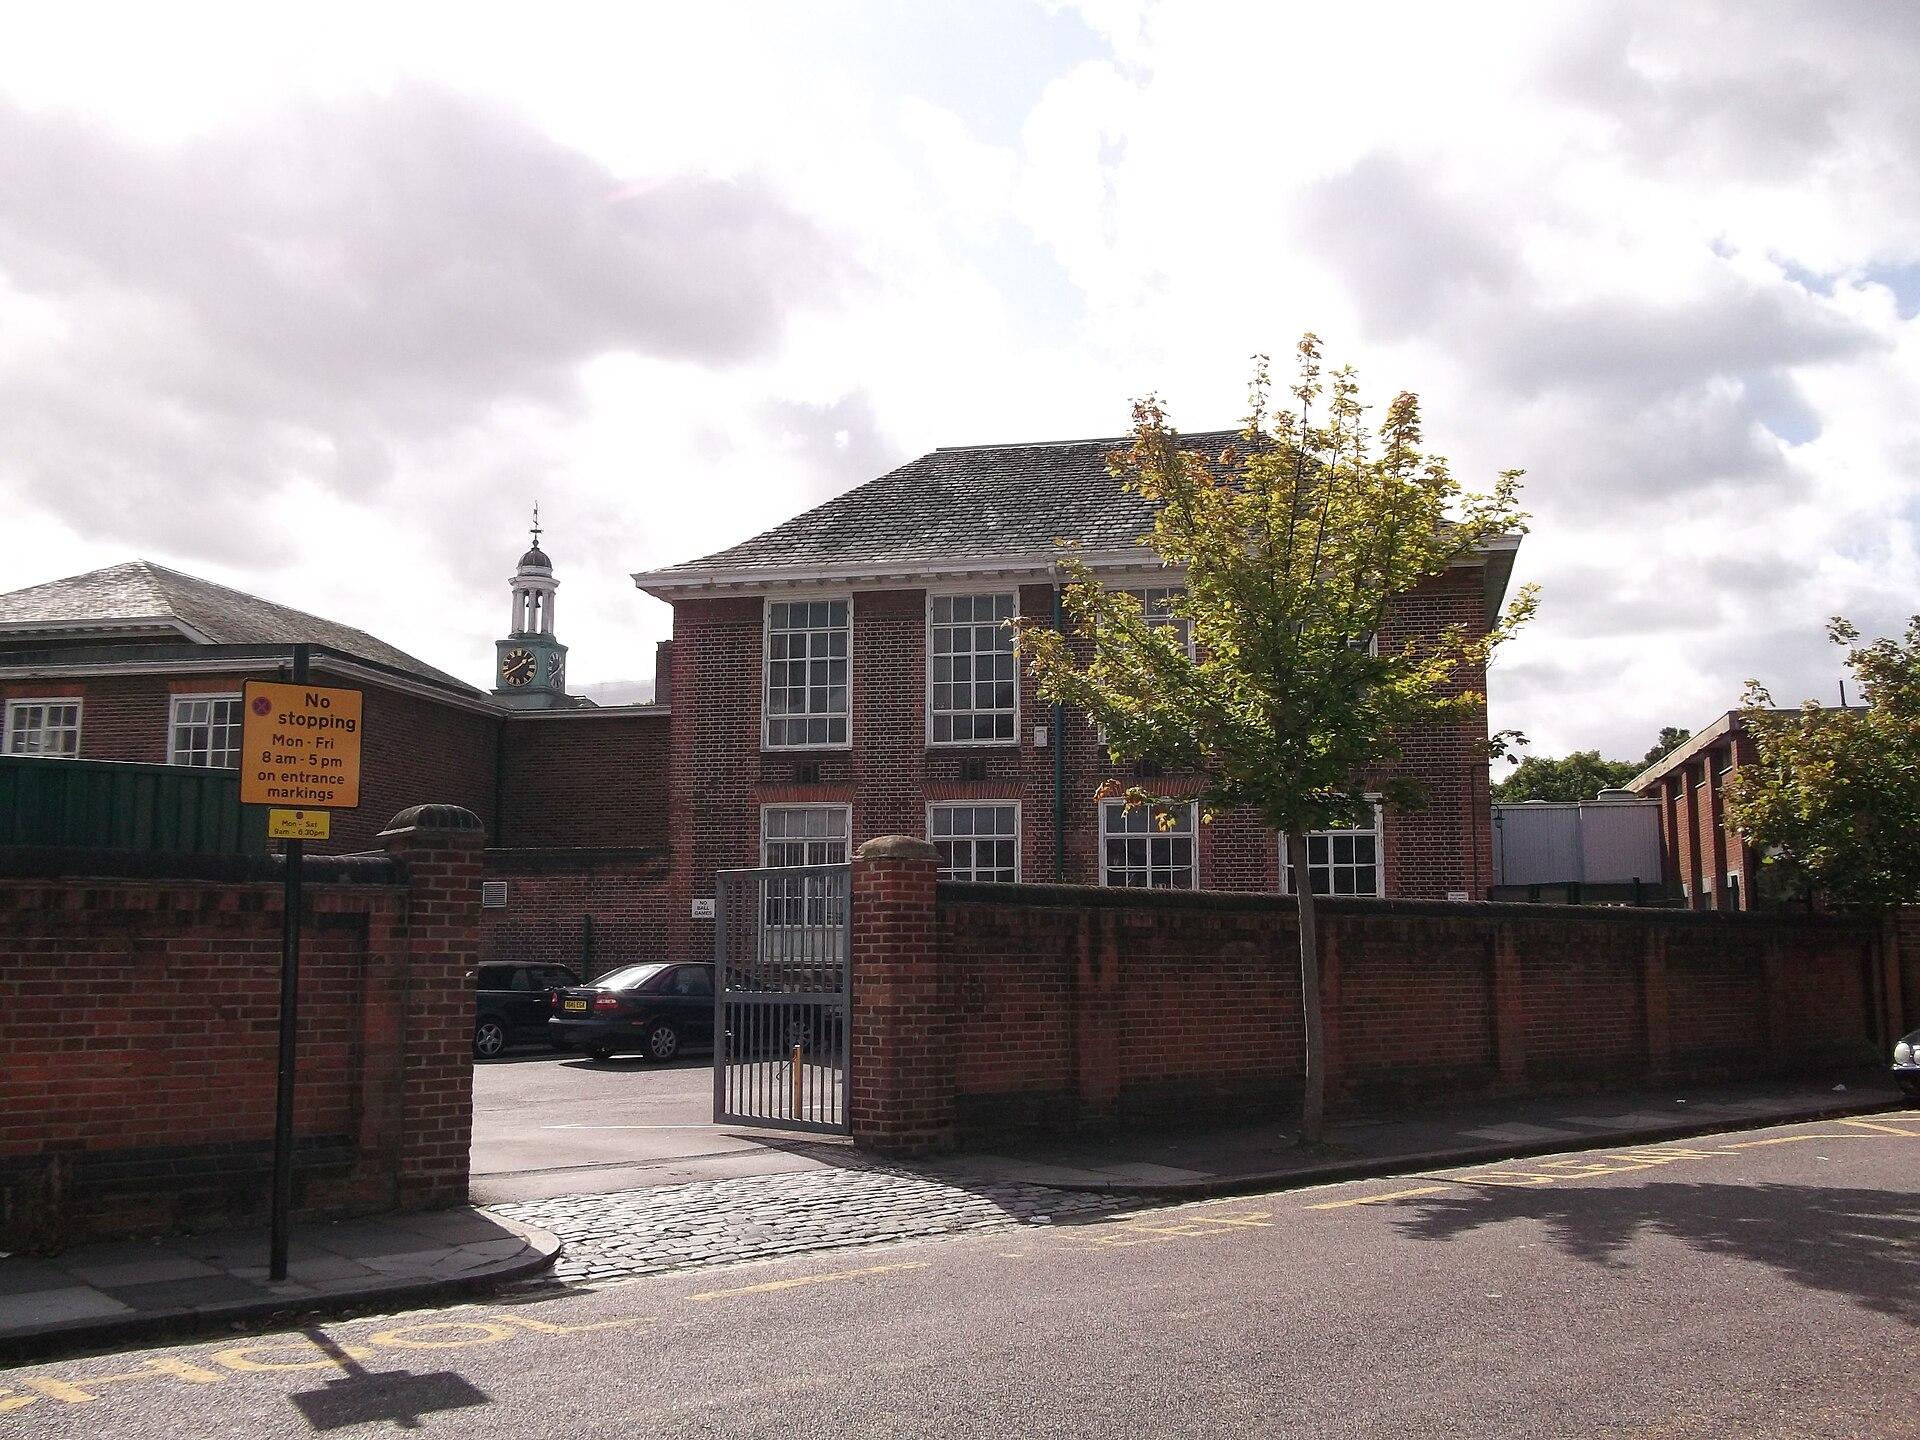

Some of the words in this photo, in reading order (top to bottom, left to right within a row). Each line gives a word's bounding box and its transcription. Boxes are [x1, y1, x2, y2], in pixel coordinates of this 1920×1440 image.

[305, 692, 330, 709] No
[278, 711, 356, 732] stopping
[272, 733, 303, 747] Mon
[315, 736, 334, 749] Fri
[262, 751, 271, 763] 8
[275, 754, 296, 764] am
[309, 754, 317, 766] 5
[321, 757, 342, 768] pm
[258, 771, 275, 781] on
[281, 771, 345, 785] entrance
[267, 787, 334, 802] markings
[0, 1315, 654, 1413] HOOL
